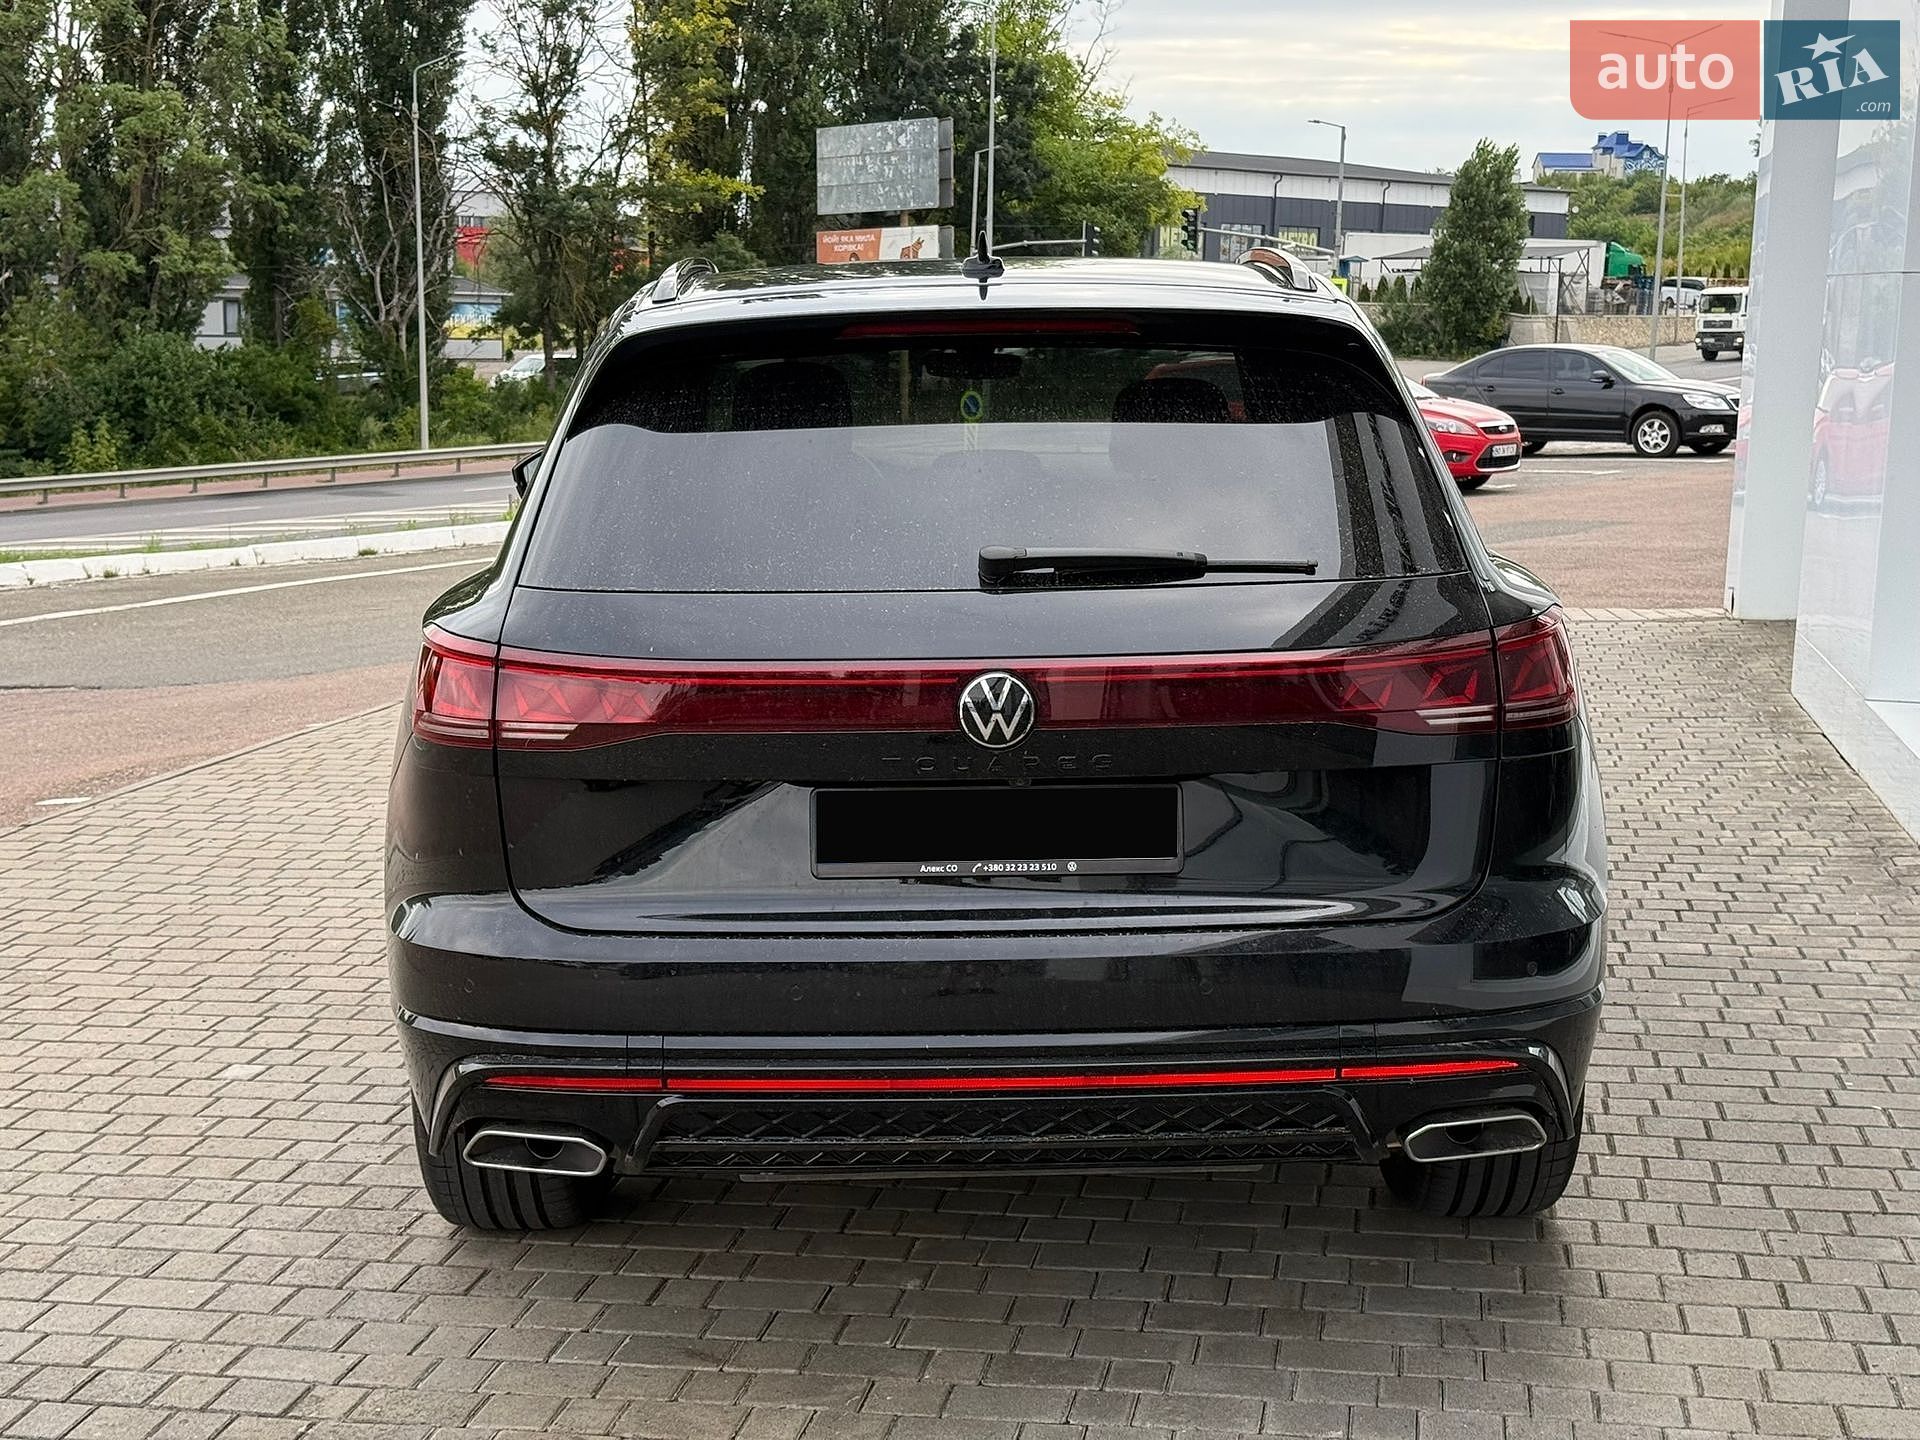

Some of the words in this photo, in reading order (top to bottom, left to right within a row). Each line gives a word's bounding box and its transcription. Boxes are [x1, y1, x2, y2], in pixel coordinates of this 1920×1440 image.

[919, 864, 945, 873] Алекс
[983, 863, 1004, 872] +380
[1005, 863, 1016, 872] 32
[1017, 863, 1028, 872] 23
[1029, 862, 1040, 871] 23
[1041, 862, 1057, 871] 510
